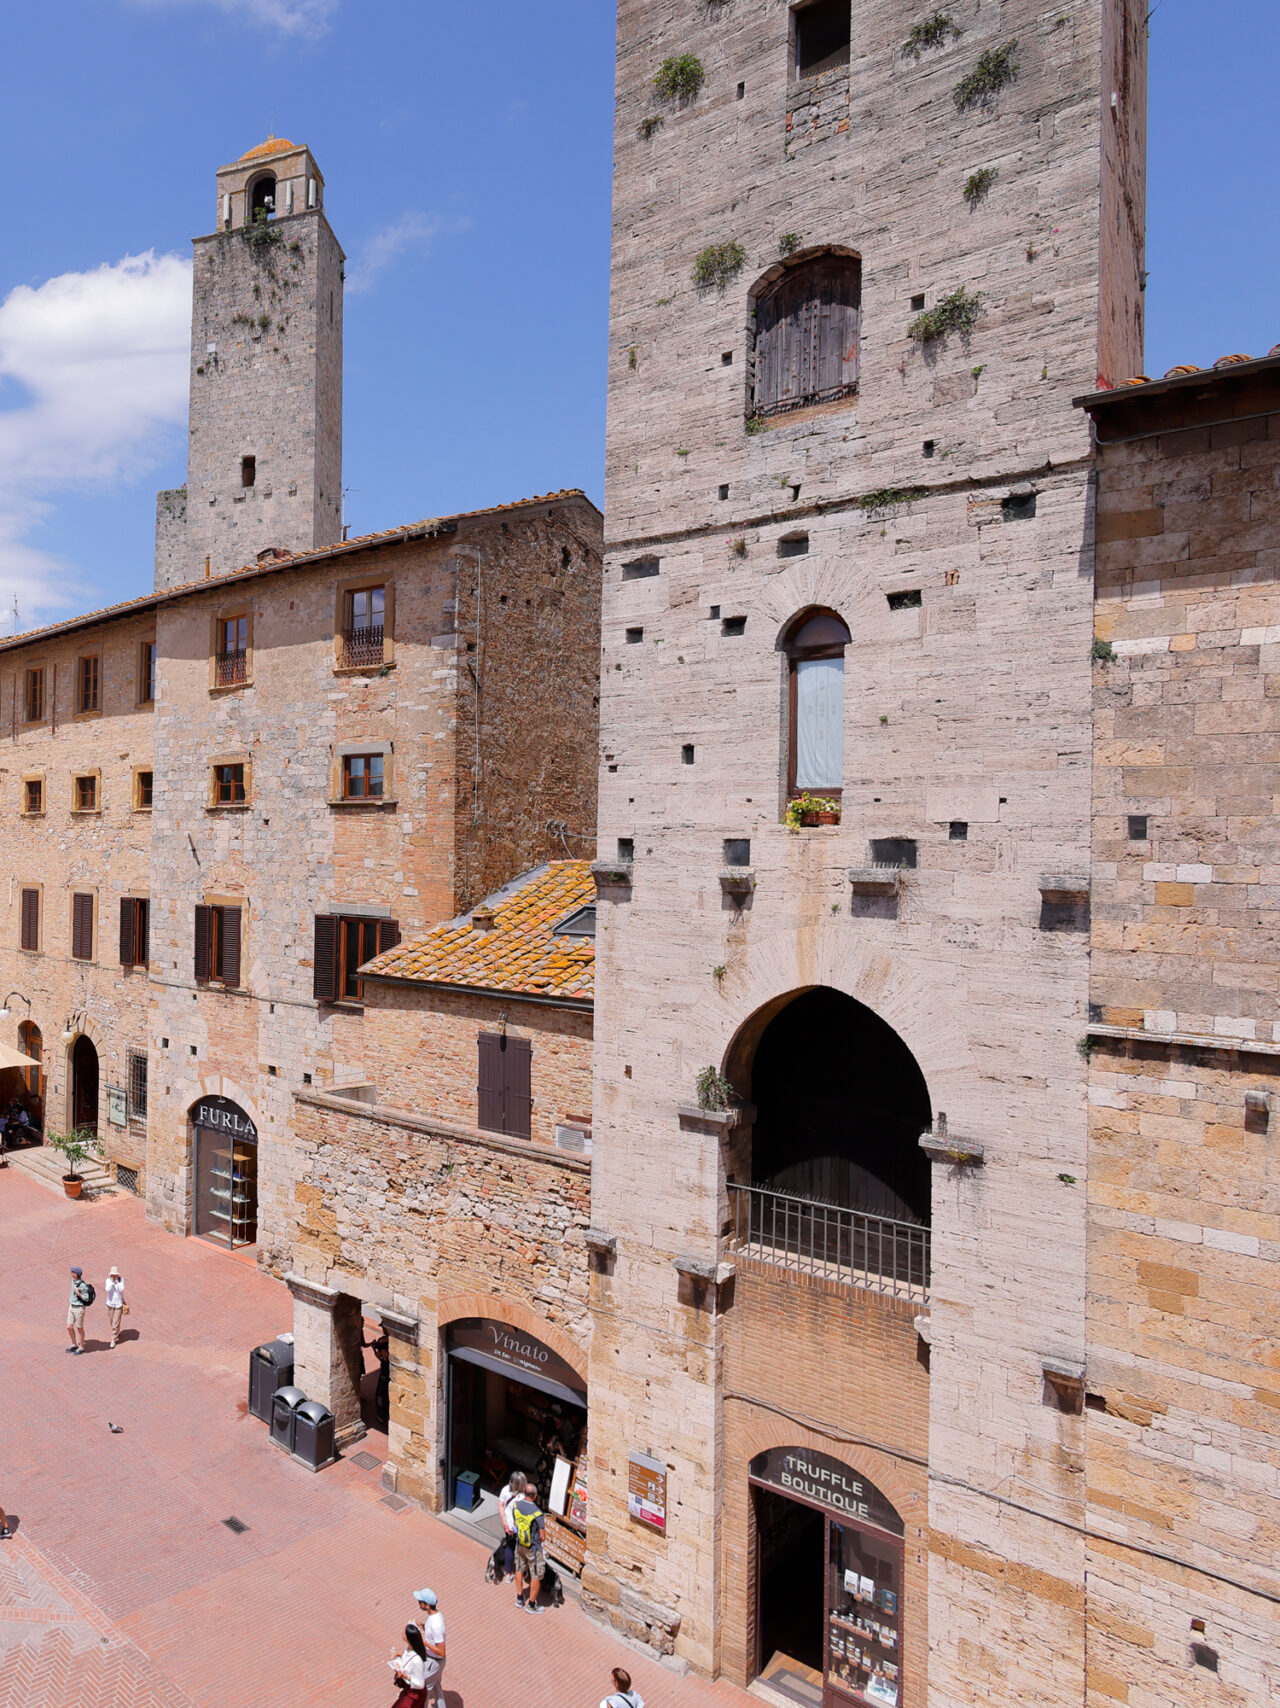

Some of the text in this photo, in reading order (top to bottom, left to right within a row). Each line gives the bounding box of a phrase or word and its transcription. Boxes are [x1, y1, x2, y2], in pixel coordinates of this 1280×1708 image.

[199, 1105, 256, 1135] FURLA
[487, 1326, 549, 1362] Vinaio
[781, 1472, 869, 1518] BOUTIQUE
[786, 1455, 863, 1497] TRUFFLE
